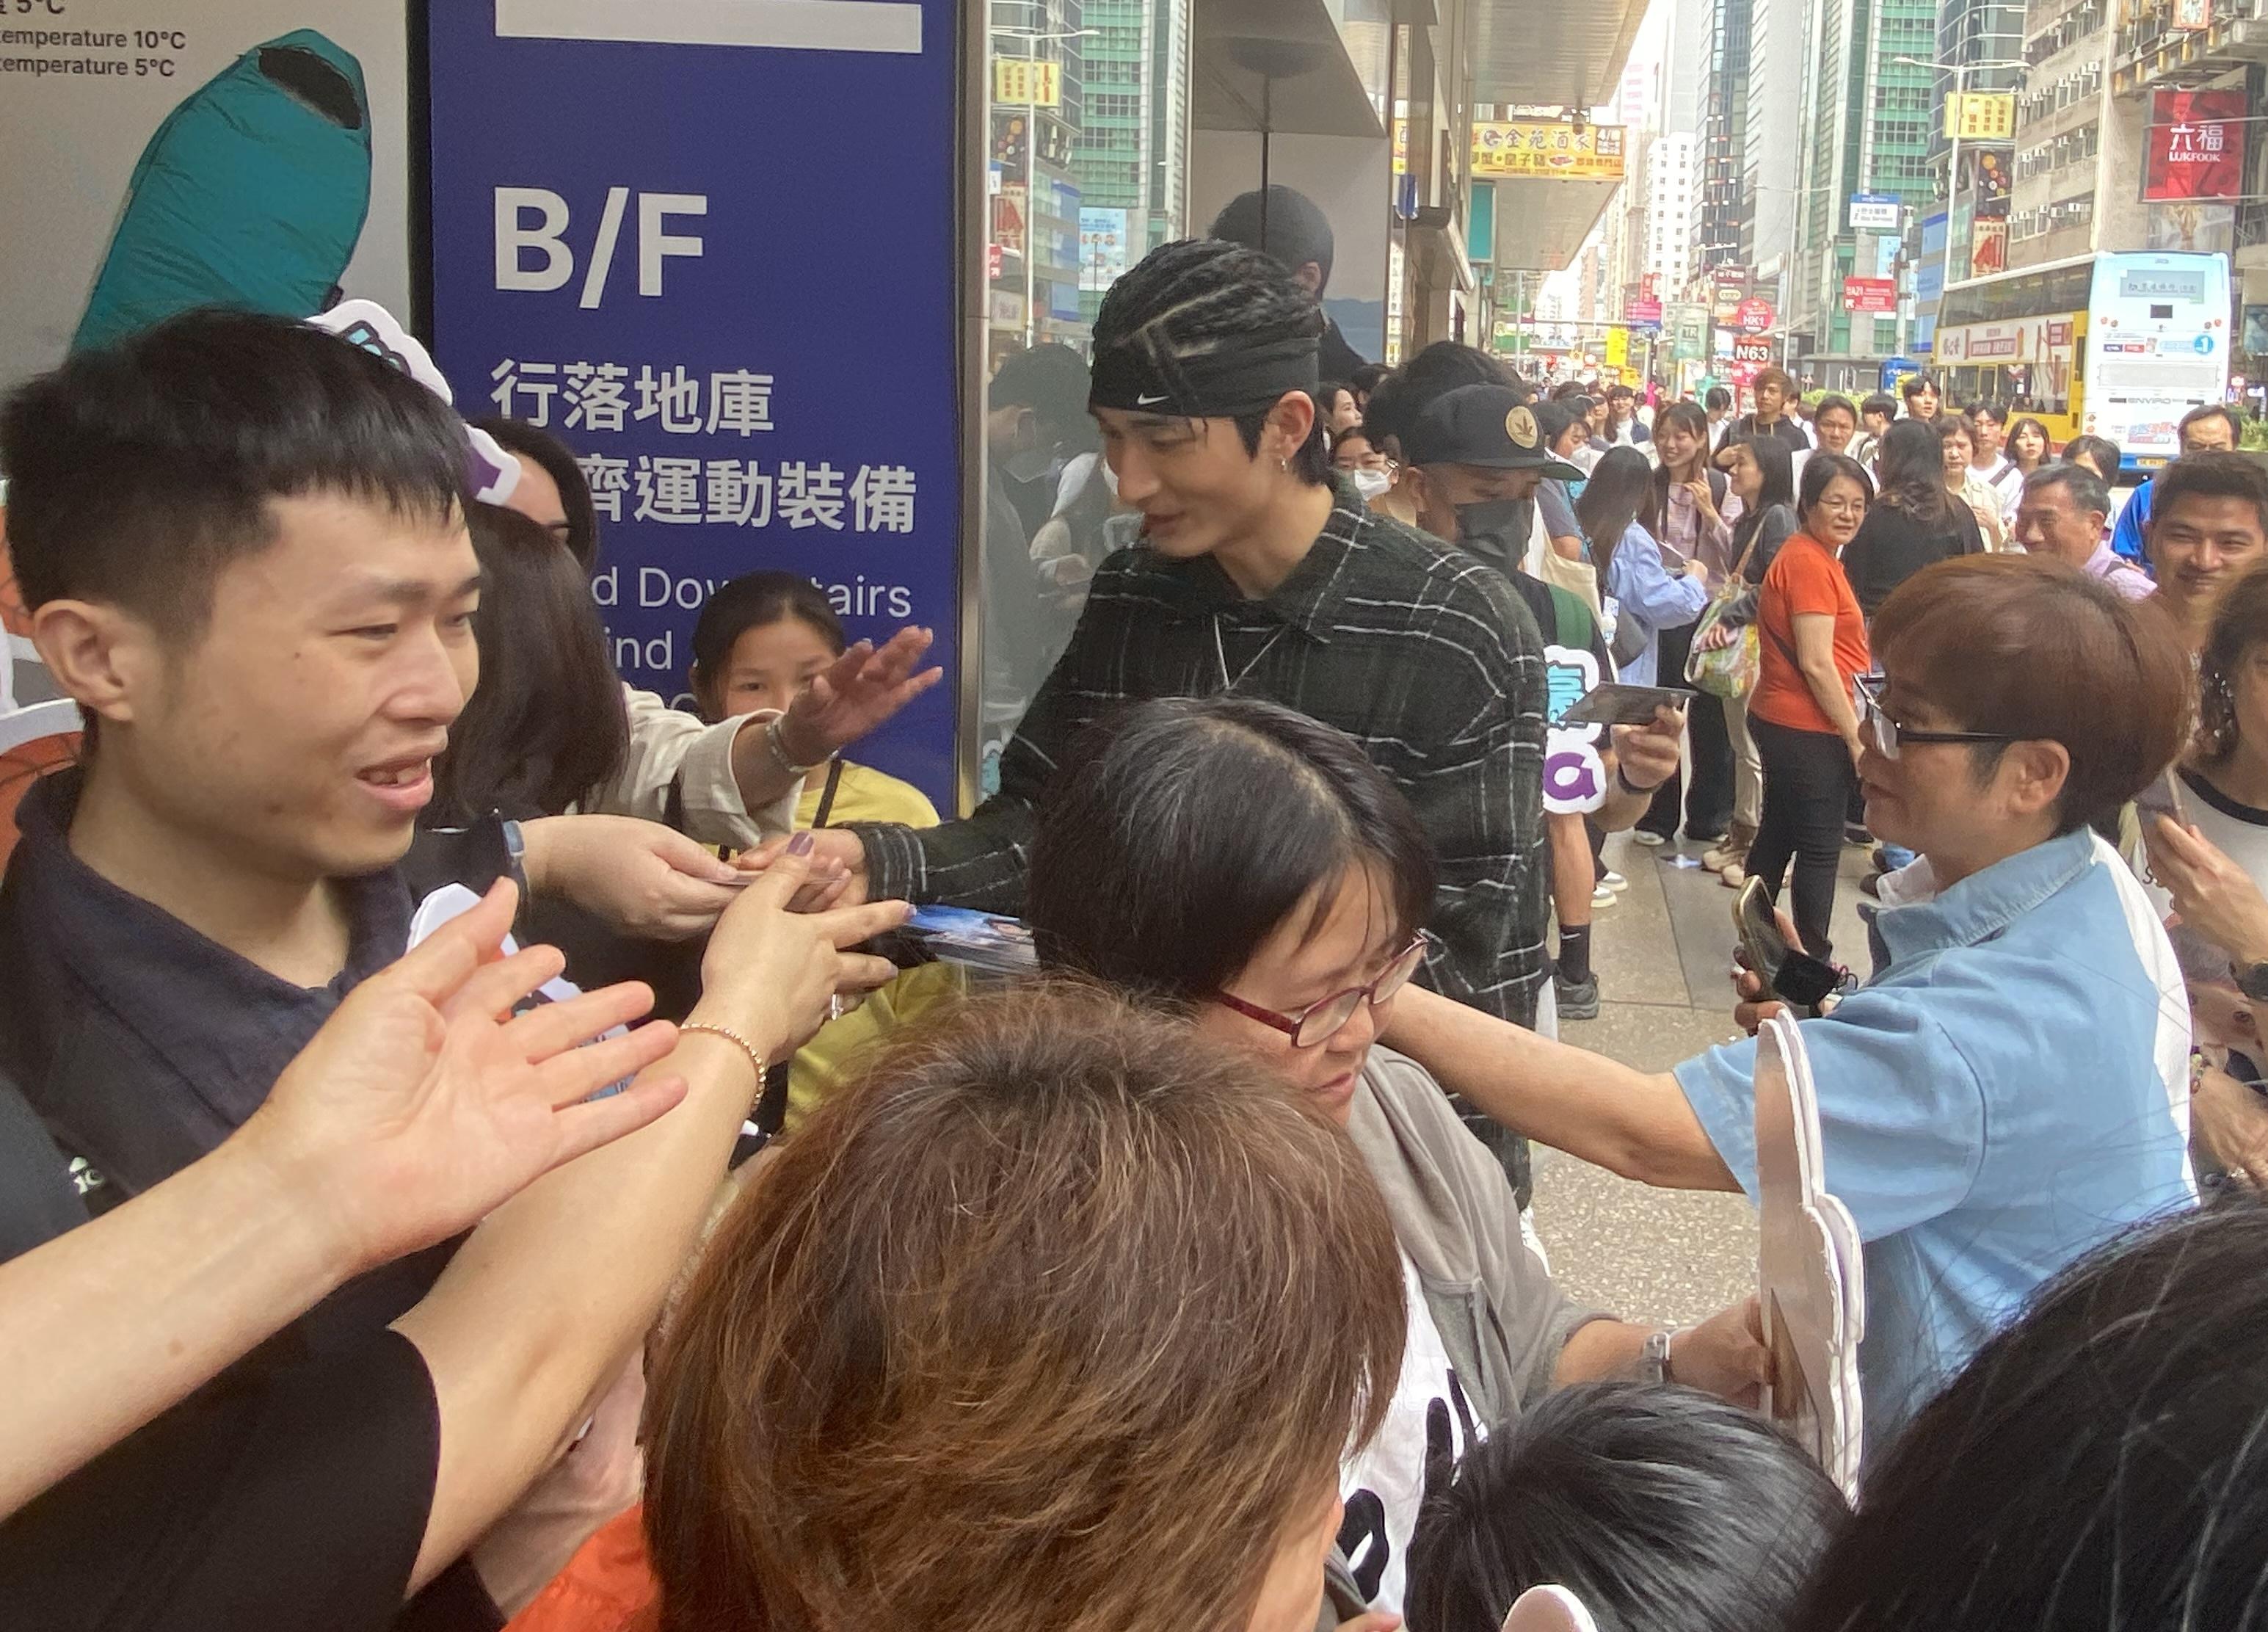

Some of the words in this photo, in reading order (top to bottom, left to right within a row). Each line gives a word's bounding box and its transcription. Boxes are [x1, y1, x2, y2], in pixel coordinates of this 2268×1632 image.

[0, 29, 128, 49] emperature
[134, 30, 186, 49] 10°C
[135, 58, 175, 76] 5°C
[2170, 123, 2224, 151] 六福
[494, 186, 708, 310] B/F
[1736, 344, 1768, 361] N63
[490, 358, 774, 437] 行落地庫
[575, 453, 917, 534] 齊運動裝備
